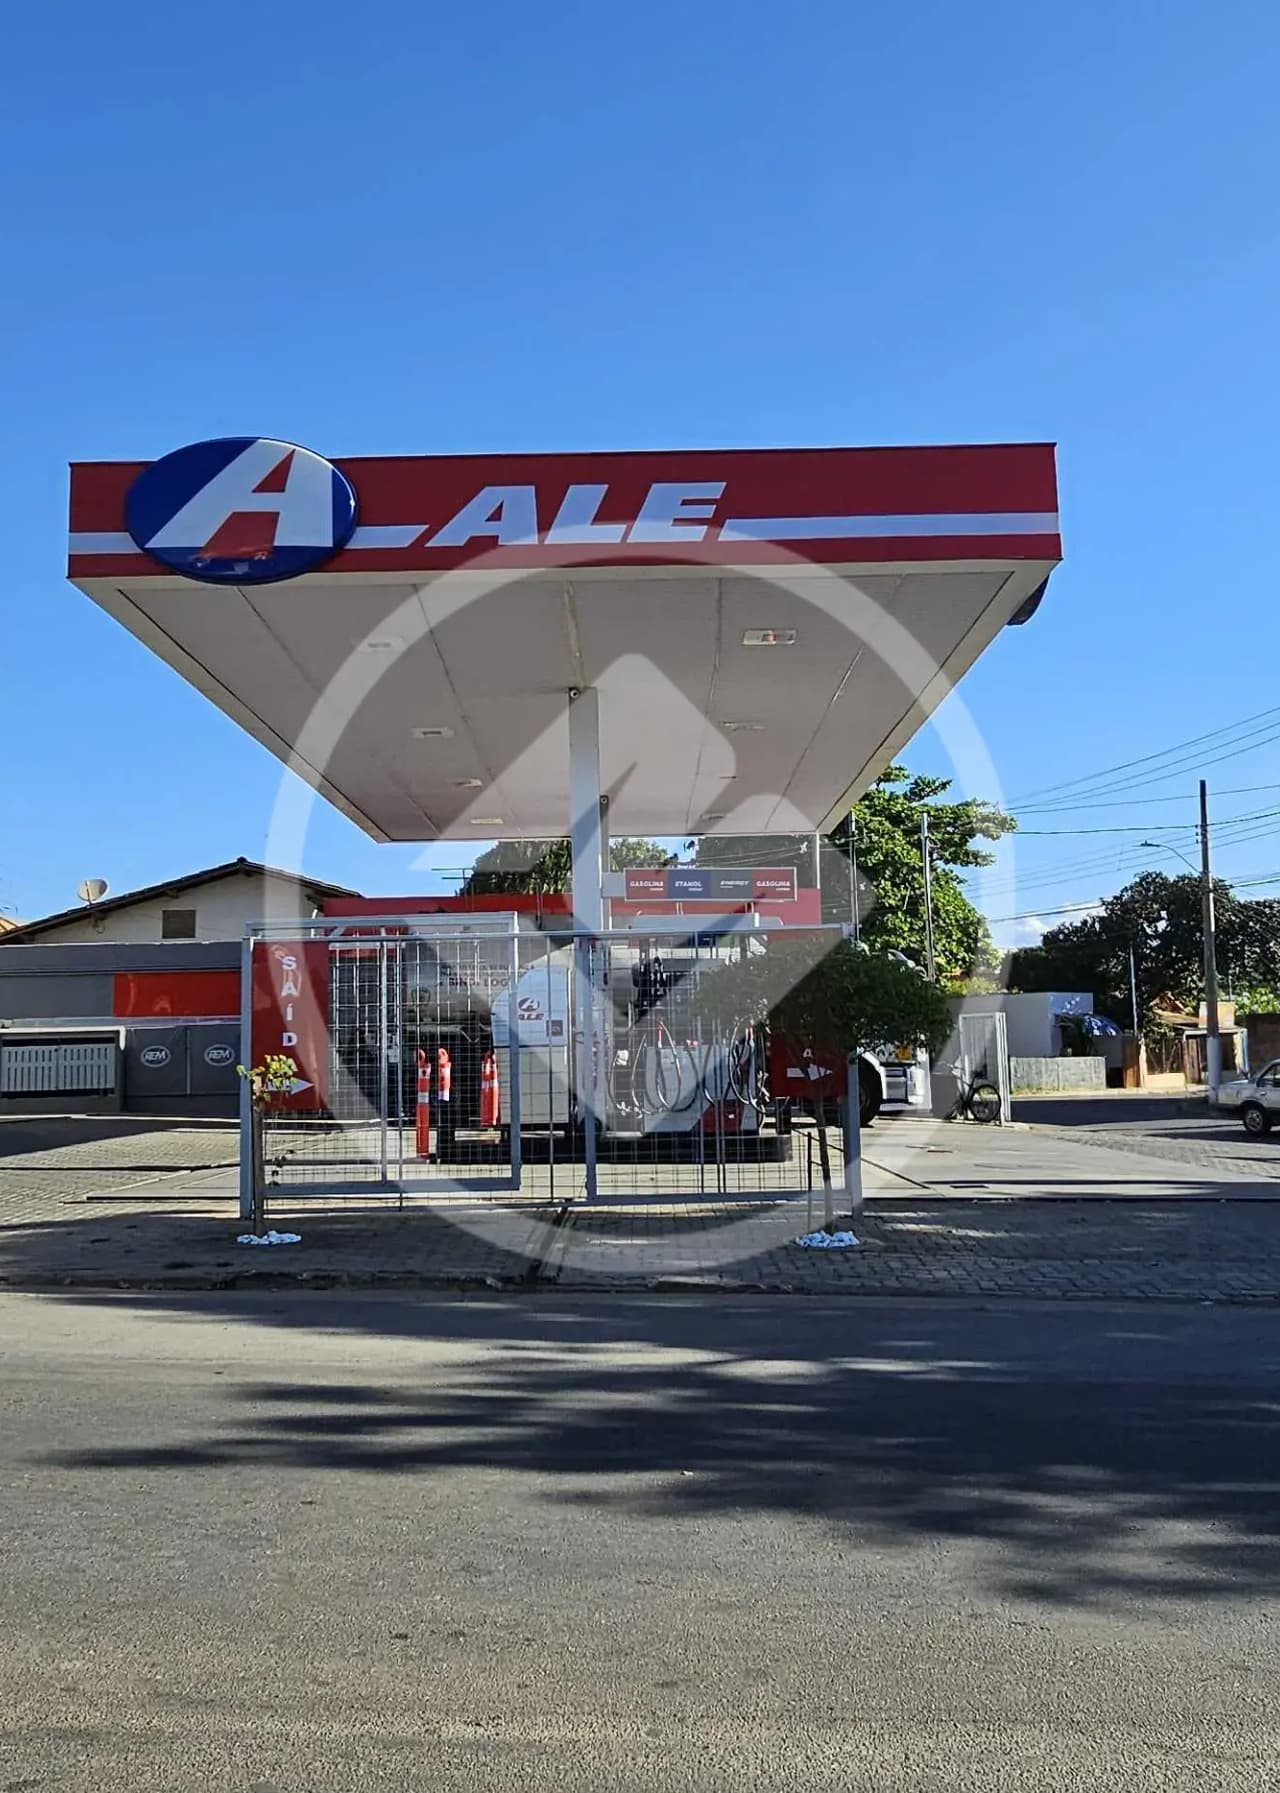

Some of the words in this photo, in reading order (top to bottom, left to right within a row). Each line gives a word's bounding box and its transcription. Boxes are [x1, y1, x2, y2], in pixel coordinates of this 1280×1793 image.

[426, 481, 726, 547] ALE
[280, 956, 300, 1047] SAÍD
[145, 1050, 166, 1061] REM
[208, 1049, 230, 1060] REM
